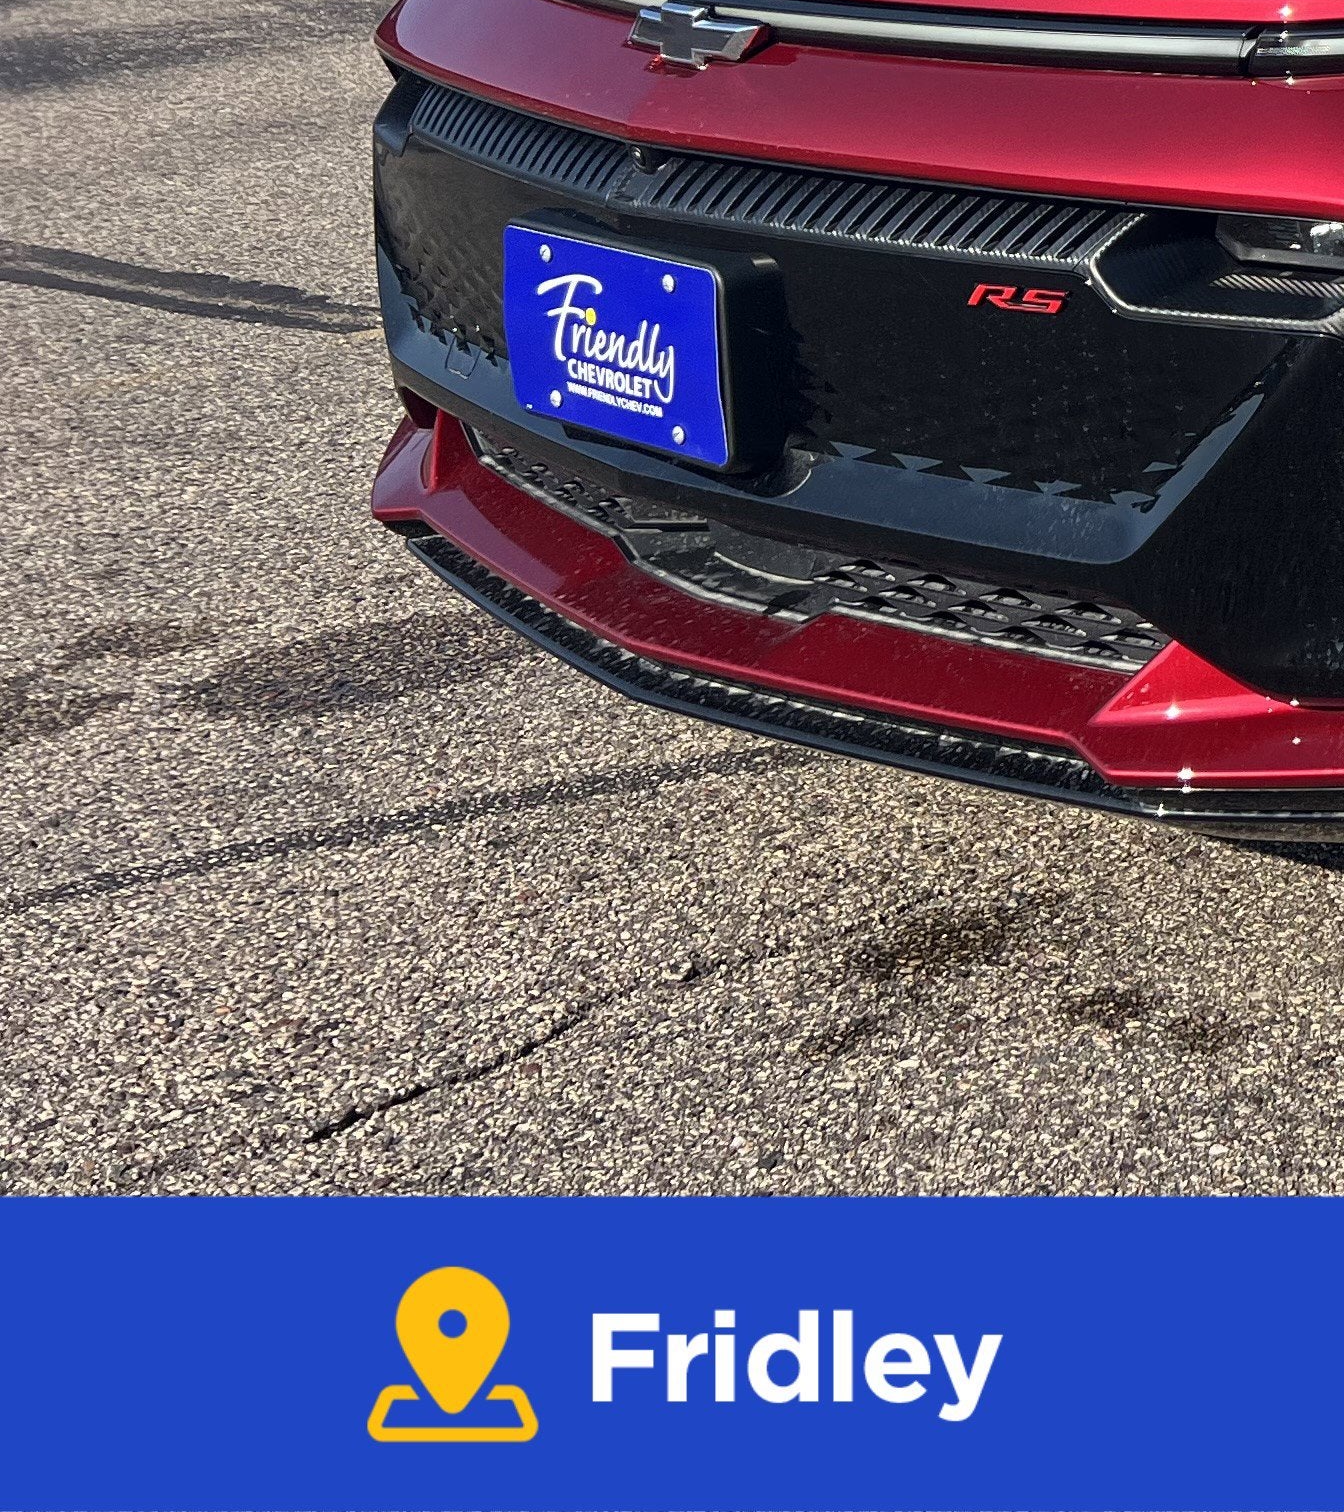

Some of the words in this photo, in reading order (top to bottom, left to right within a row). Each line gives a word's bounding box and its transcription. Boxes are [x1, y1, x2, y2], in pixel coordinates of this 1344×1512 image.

[966, 282, 1068, 315] RS
[536, 273, 677, 403] Friendly
[567, 358, 654, 398] CHEVROLET
